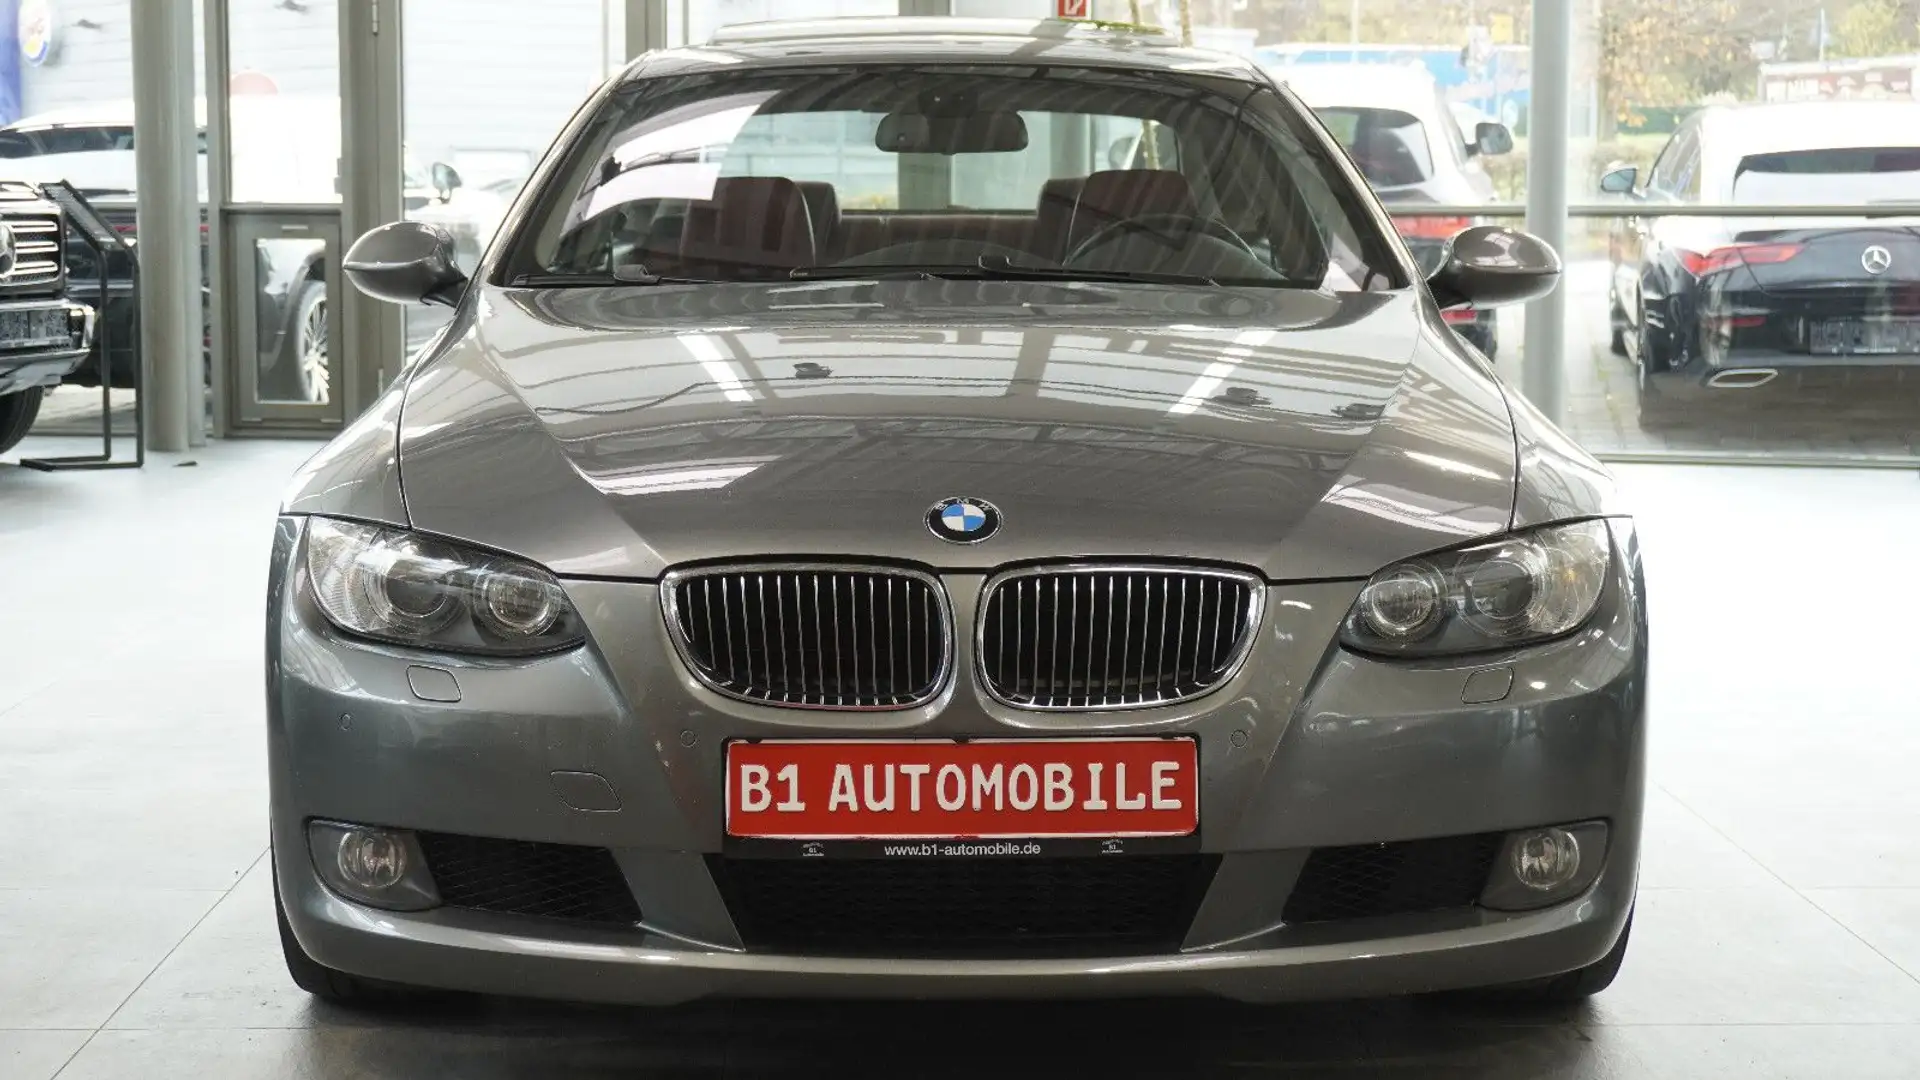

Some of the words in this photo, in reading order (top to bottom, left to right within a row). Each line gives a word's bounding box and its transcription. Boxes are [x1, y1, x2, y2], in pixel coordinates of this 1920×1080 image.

[740, 763, 806, 812] B1
[828, 761, 1183, 812] AUTOMOBILE
[884, 841, 1042, 856] www.b1-automobile.de
